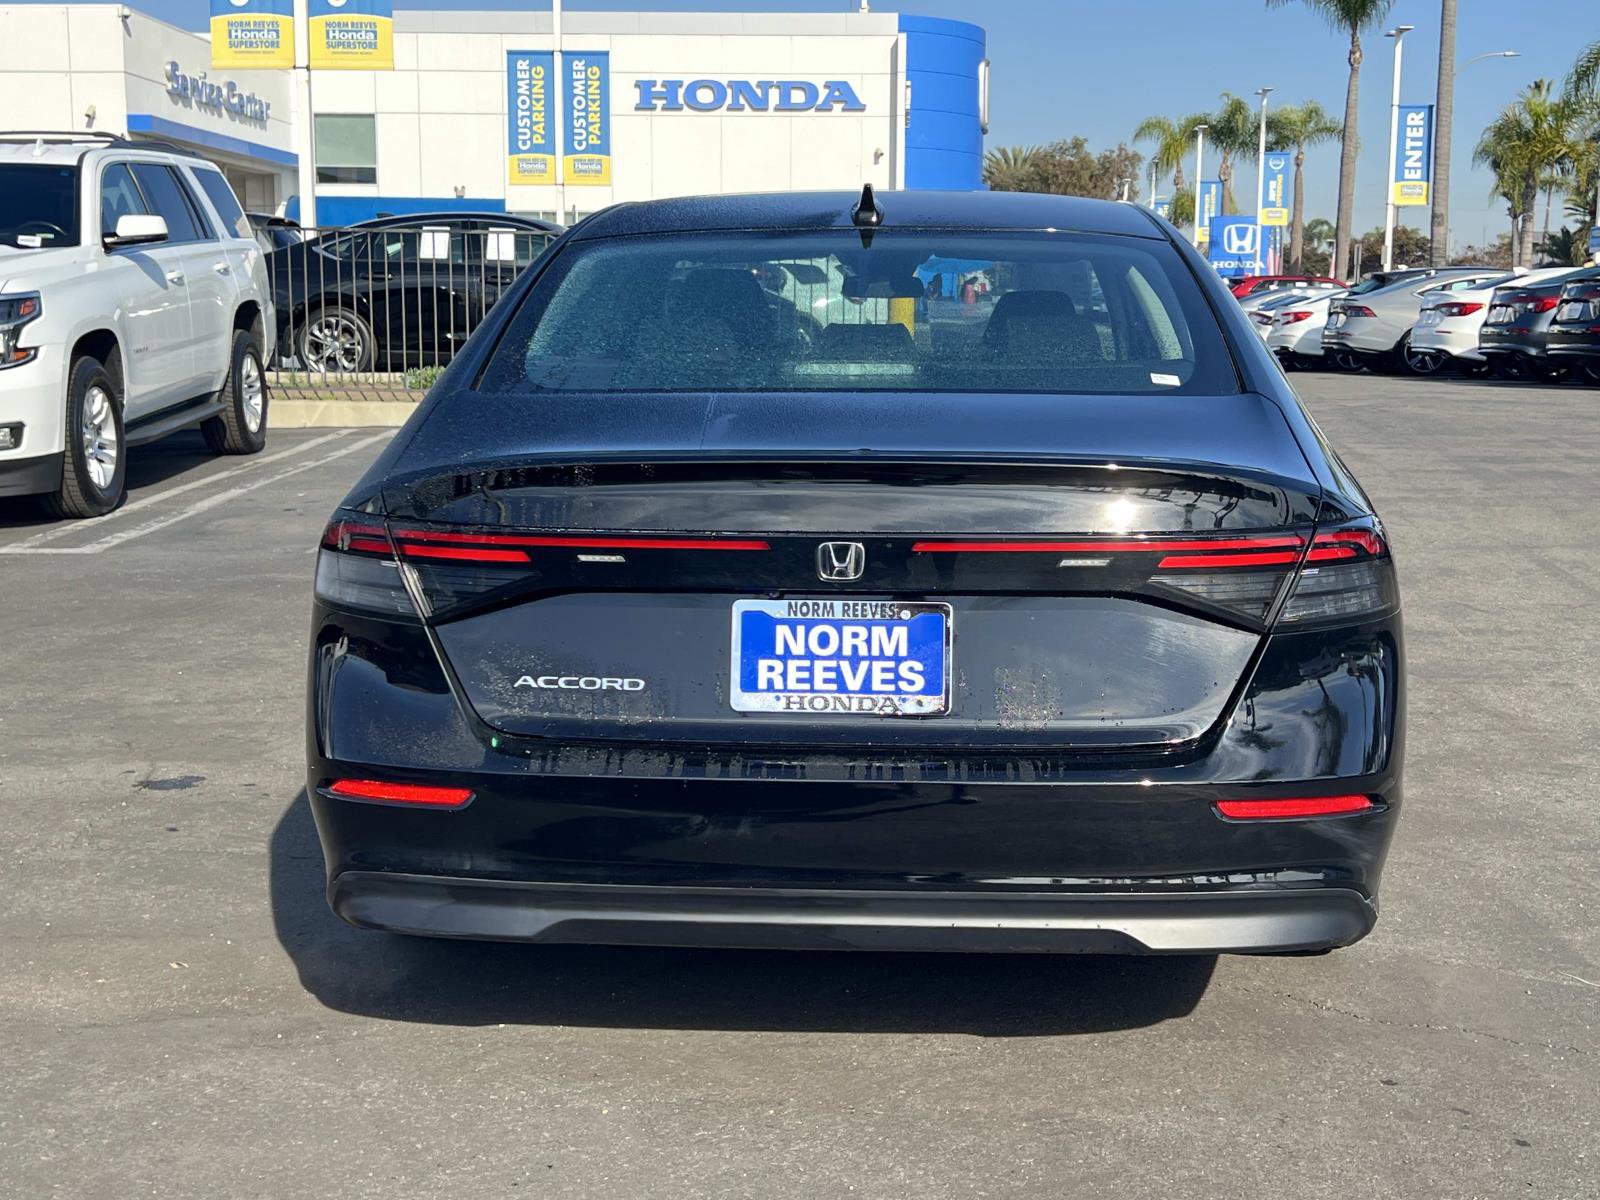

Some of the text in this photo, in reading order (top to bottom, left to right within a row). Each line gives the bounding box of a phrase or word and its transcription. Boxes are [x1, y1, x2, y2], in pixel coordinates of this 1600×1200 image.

[231, 29, 277, 39] Honda
[325, 21, 349, 29] NORM
[328, 30, 375, 40] Honda
[229, 40, 280, 48] SUPERSTORE
[326, 41, 378, 49] SUPERSTORE
[164, 60, 271, 121] Service Center
[634, 79, 867, 112] HONDA
[516, 59, 531, 151] CUSTOMER
[532, 65, 545, 144] PARKING
[572, 59, 587, 151] CUSTOMER
[587, 65, 601, 145] PARKING
[1404, 111, 1425, 180] ENTER
[1212, 260, 1266, 269] HONDA
[787, 601, 897, 619] NORM REEVES
[775, 624, 908, 657] NORM
[513, 675, 646, 691] ACCORD
[757, 659, 926, 693] REEVES
[782, 694, 902, 712] HONDA
